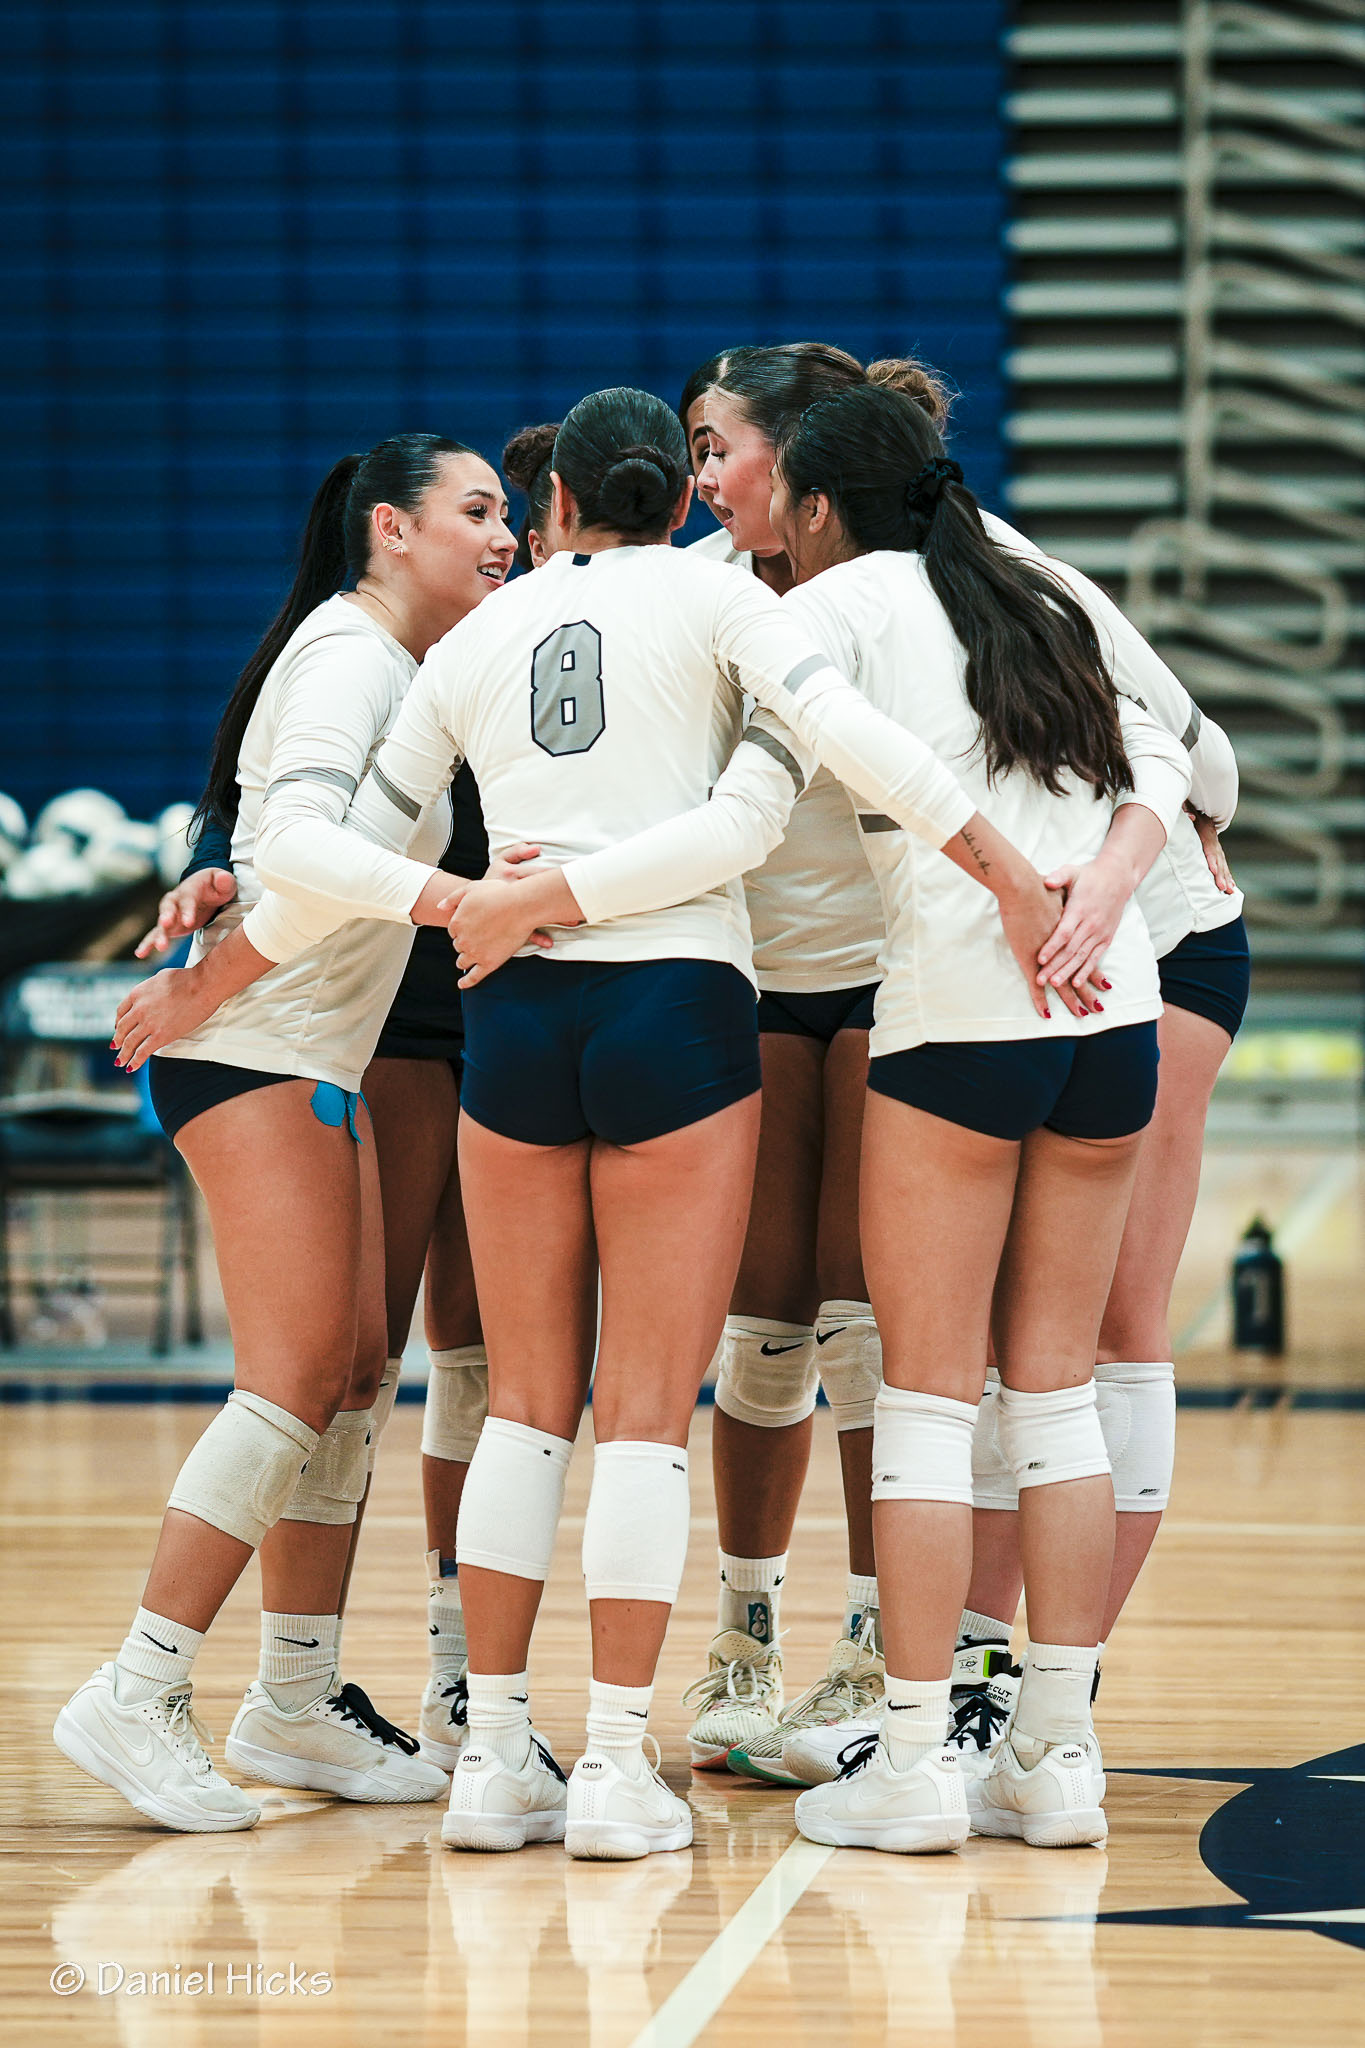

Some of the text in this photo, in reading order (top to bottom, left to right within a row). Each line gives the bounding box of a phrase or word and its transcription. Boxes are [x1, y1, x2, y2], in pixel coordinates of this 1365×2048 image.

[531, 619, 606, 757] 8
[992, 1686, 1013, 1698] CUT
[462, 1755, 482, 1763] 001
[582, 1762, 603, 1770] 001
